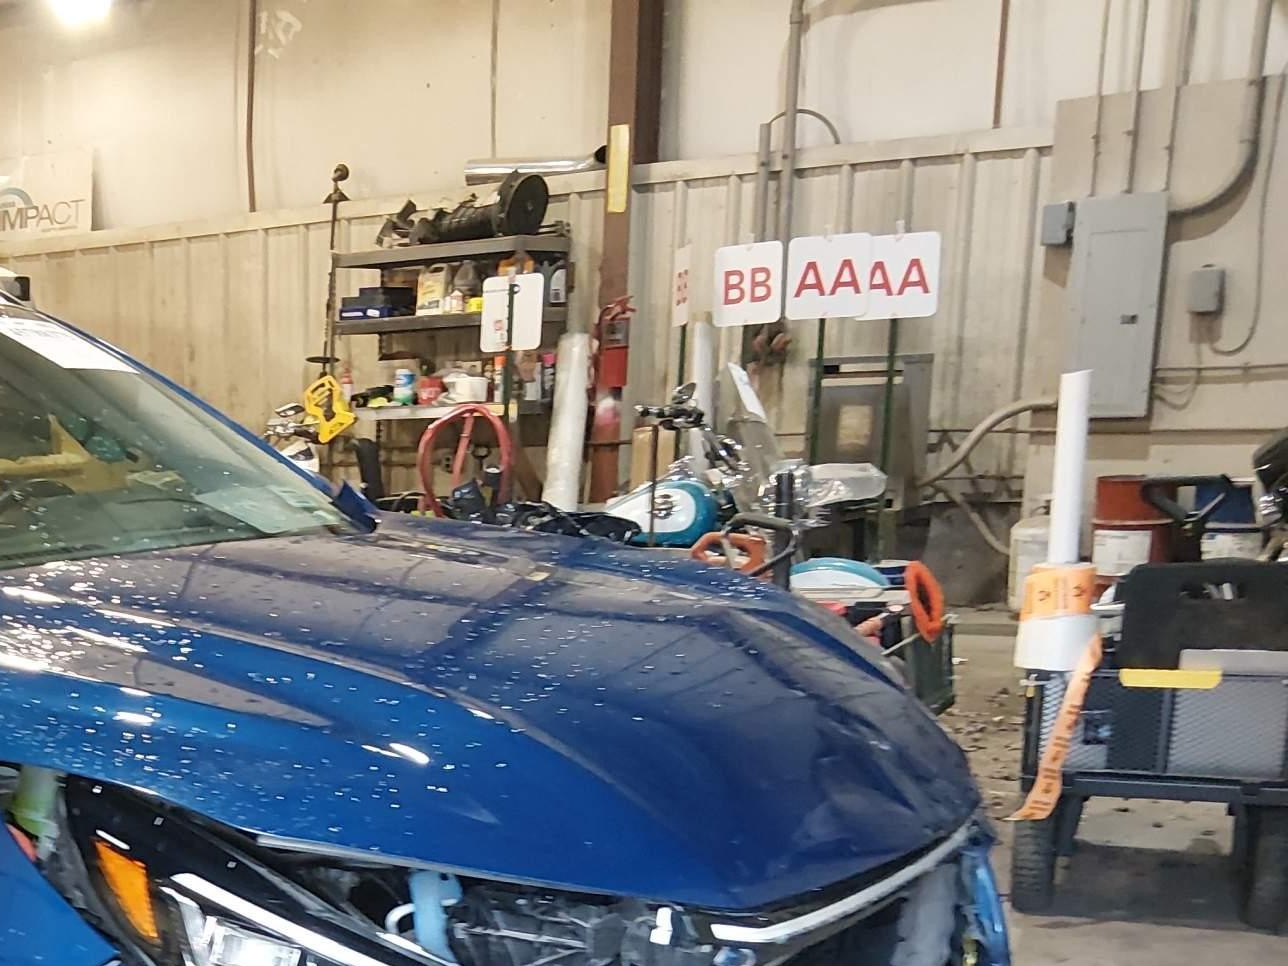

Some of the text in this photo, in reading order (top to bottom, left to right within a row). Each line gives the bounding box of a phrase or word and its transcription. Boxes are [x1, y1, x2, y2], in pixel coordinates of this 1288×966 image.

[722, 266, 773, 306] BB
[793, 258, 862, 298] AA
[868, 257, 931, 297] AA
